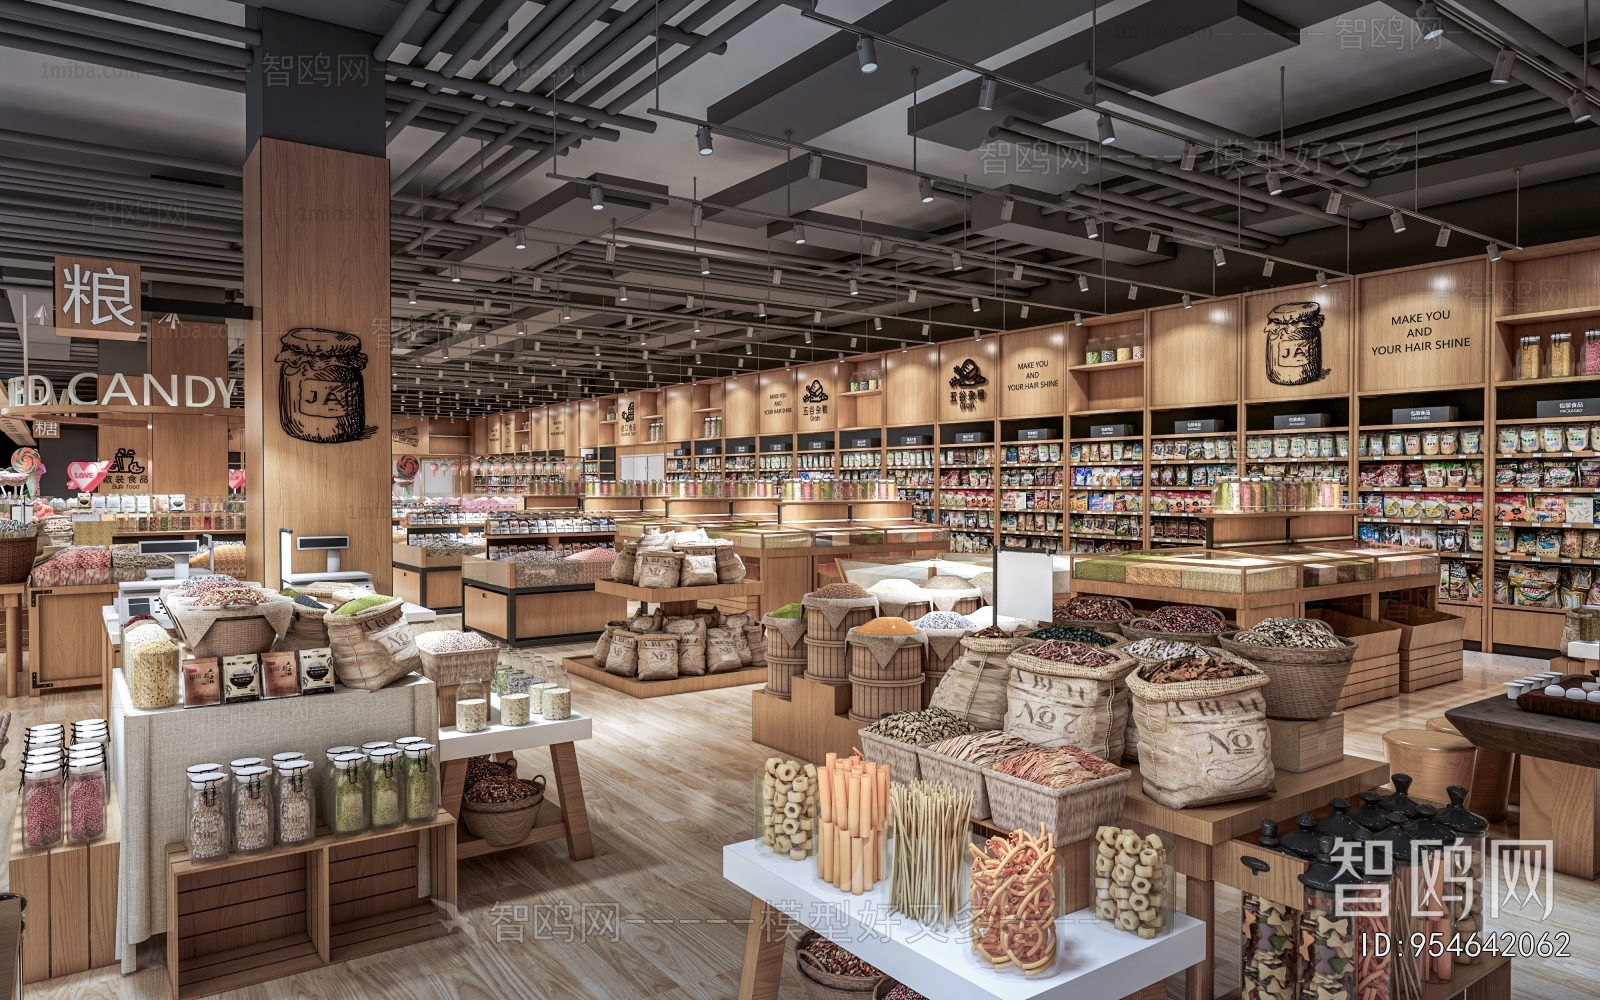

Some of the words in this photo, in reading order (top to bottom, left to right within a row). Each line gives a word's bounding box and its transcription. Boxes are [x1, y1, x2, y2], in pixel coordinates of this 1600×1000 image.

[63, 263, 136, 327] 粮
[1391, 313, 1423, 325] MAKE
[1426, 310, 1451, 321] YOU
[1406, 327, 1433, 338] AND
[1372, 345, 1402, 355] YOUR
[1405, 341, 1432, 352] HAIR
[1435, 337, 1471, 349] SHINE
[1017, 361, 1034, 370] MAKE
[1036, 360, 1049, 368] YOU
[68, 373, 237, 408] CANDY
[1007, 383, 1024, 391] YOUR
[1024, 381, 1039, 390] HAIR
[1040, 380, 1059, 388] SHINE
